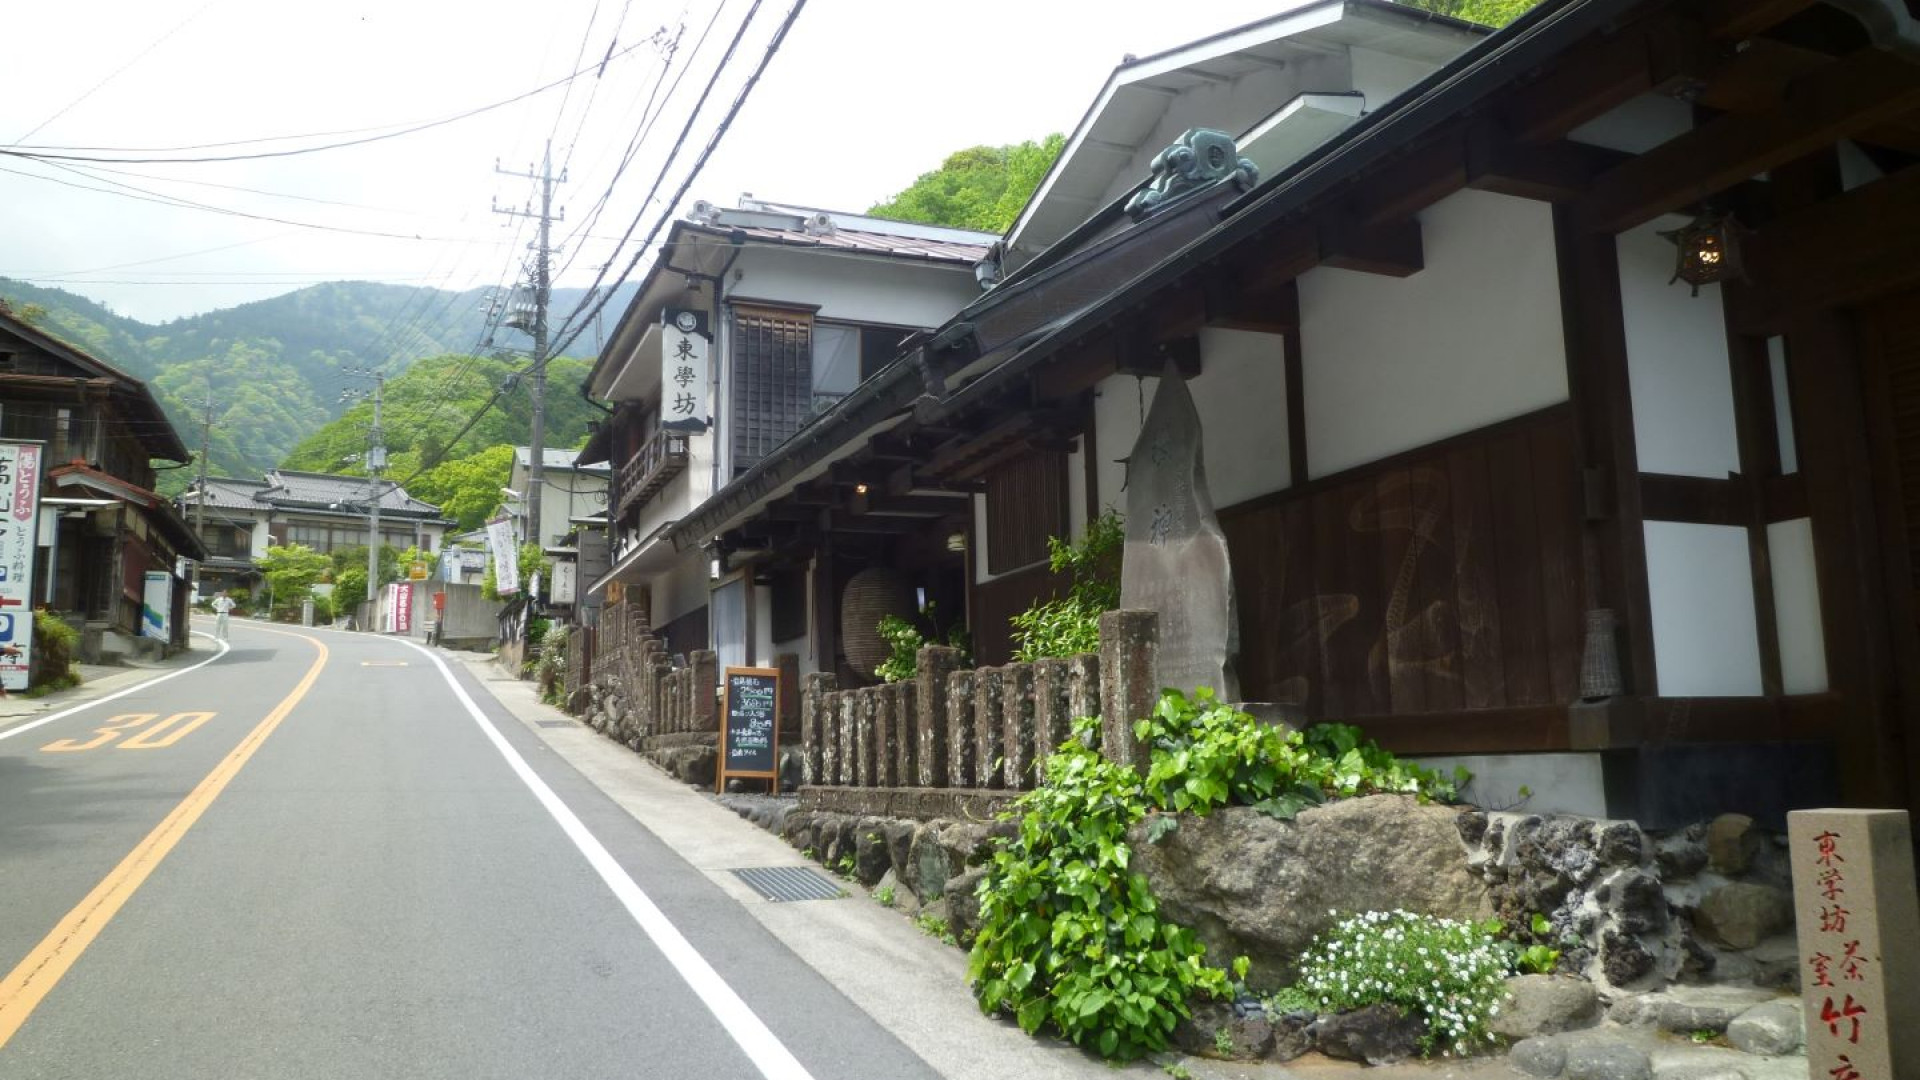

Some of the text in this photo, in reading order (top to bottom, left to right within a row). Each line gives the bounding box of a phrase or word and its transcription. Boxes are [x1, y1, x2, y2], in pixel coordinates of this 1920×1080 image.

[672, 336, 698, 415] 東學坊
[16, 452, 35, 515] 湯とうふ
[13, 526, 26, 584] とうふ料理
[39, 711, 218, 752] 30
[1812, 830, 1850, 933] 東学坊
